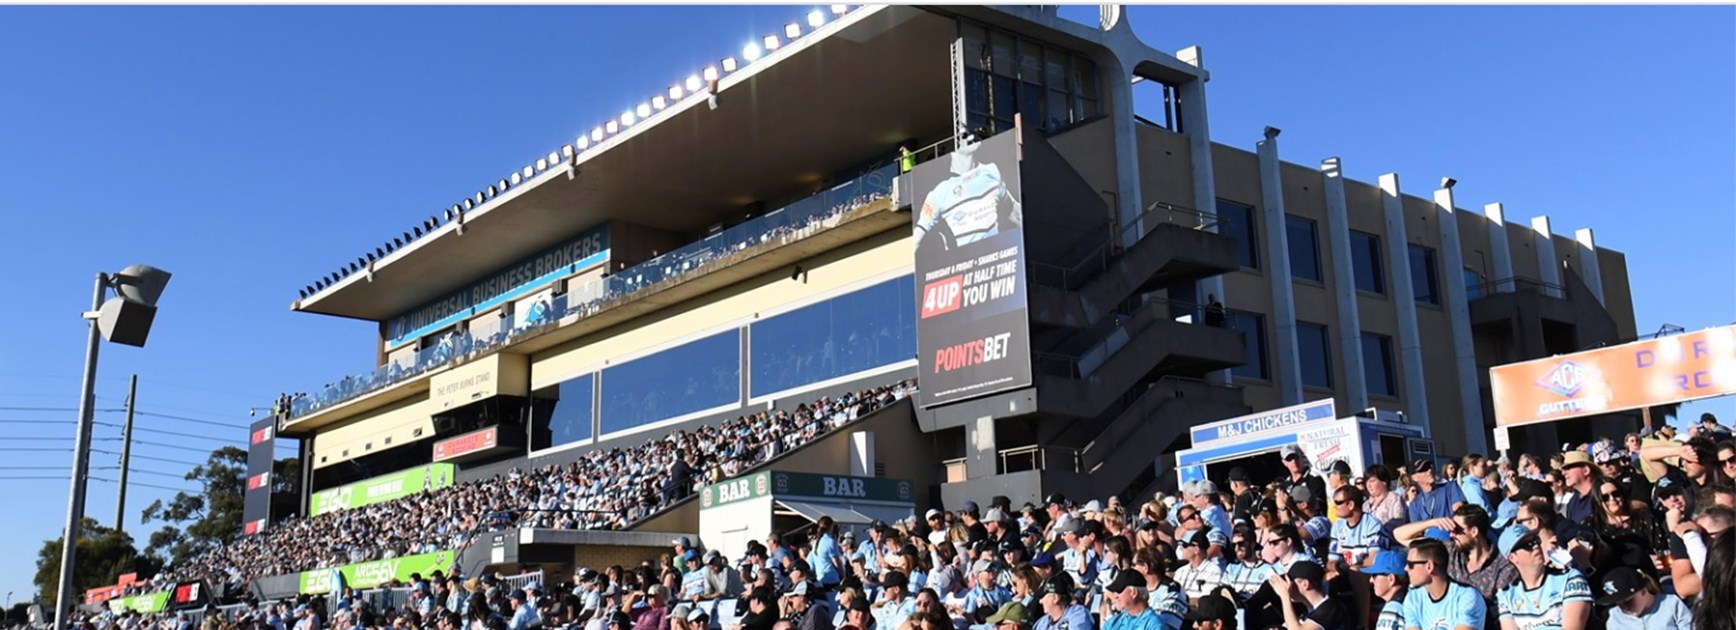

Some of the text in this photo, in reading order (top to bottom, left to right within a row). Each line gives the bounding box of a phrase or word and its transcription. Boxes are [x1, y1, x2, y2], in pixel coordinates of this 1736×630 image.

[955, 259, 974, 272] FRIDAY
[978, 252, 1000, 266] SHARKS
[999, 246, 1018, 260] GAMES
[962, 259, 1018, 287] AT HALF TIME
[411, 233, 600, 330] UNIVERSAL BUSINESS BROKERS
[962, 275, 1015, 307] YOU WIN
[925, 282, 959, 311] 4UP
[934, 332, 1011, 373] POINTSBET
[475, 371, 491, 385] STAND
[1217, 409, 1307, 438] M&J CHICKENS
[1307, 426, 1345, 440] NATURAL
[718, 479, 750, 503] BAR
[823, 477, 866, 497] BAR
